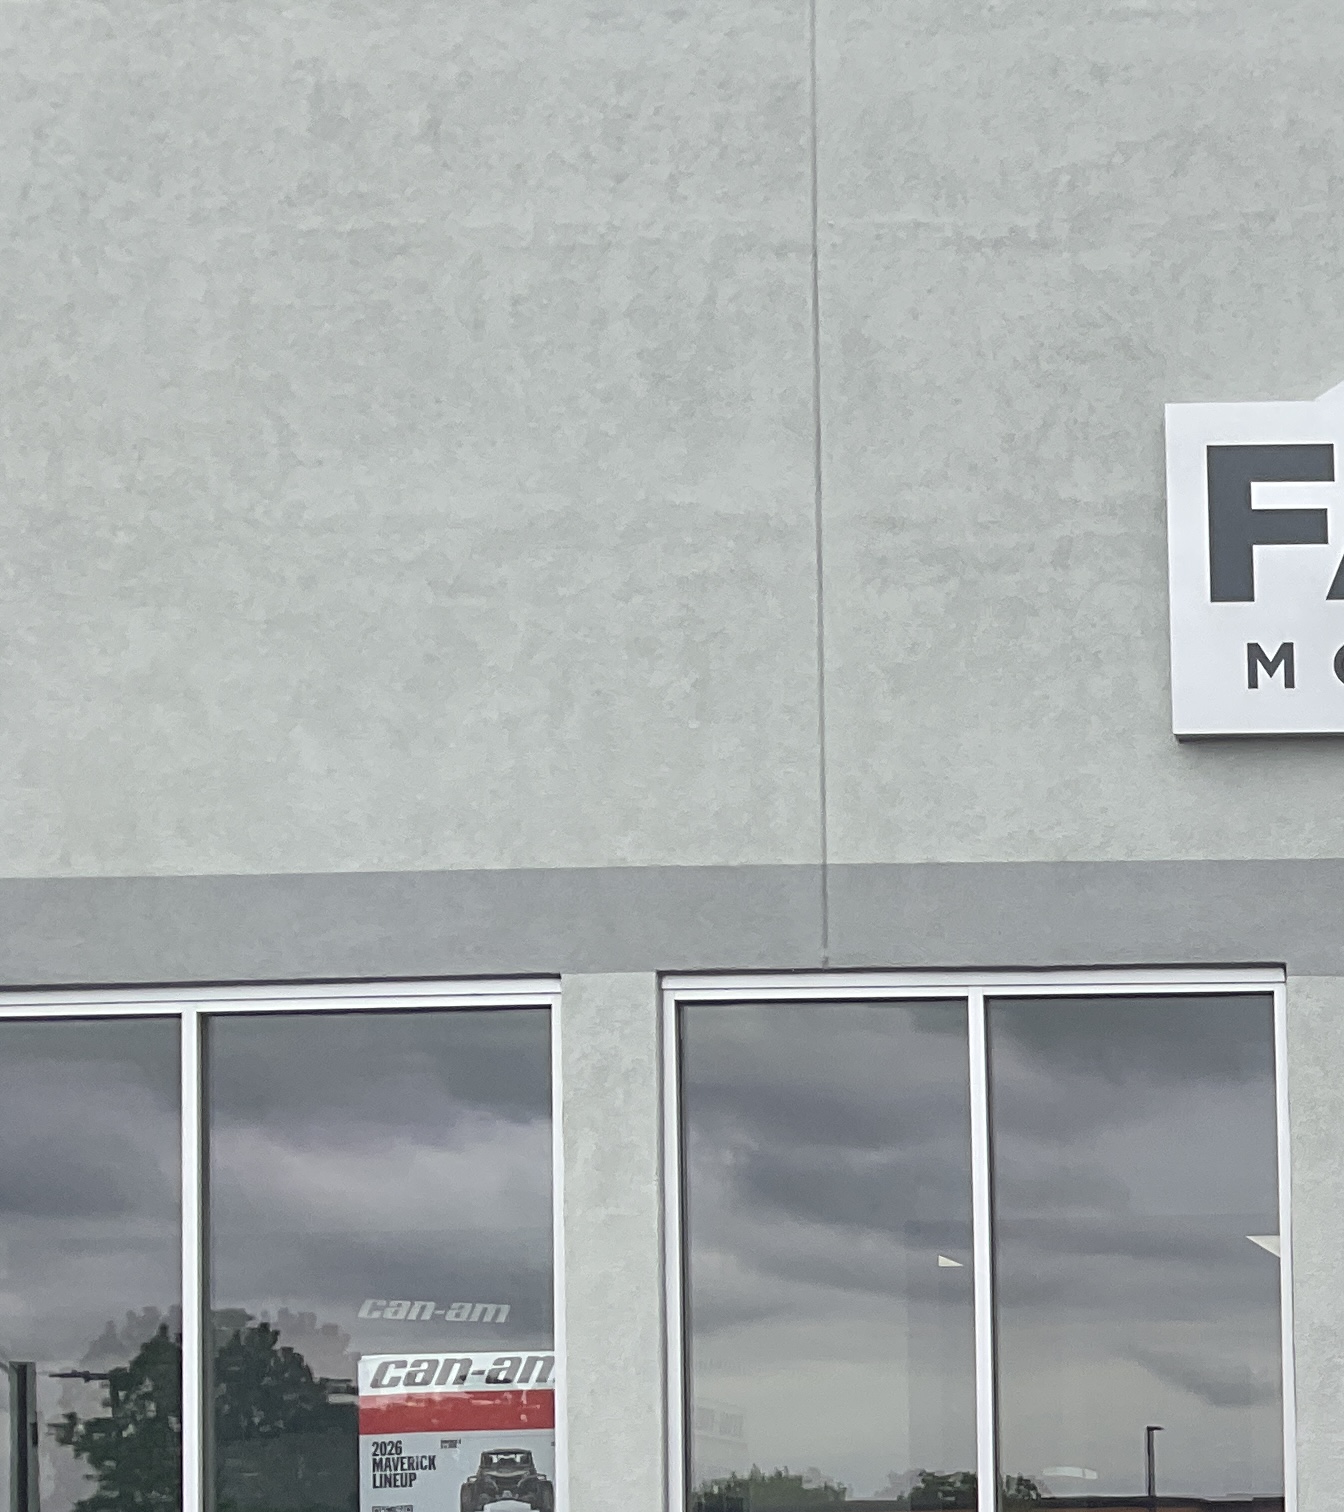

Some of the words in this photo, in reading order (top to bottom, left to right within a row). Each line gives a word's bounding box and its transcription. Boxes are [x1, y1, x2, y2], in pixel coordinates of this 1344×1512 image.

[357, 1299, 511, 1324] can-am
[372, 1440, 403, 1457] 2026
[372, 1455, 437, 1473] MAVERICK
[372, 1472, 418, 1489] LINEUP
